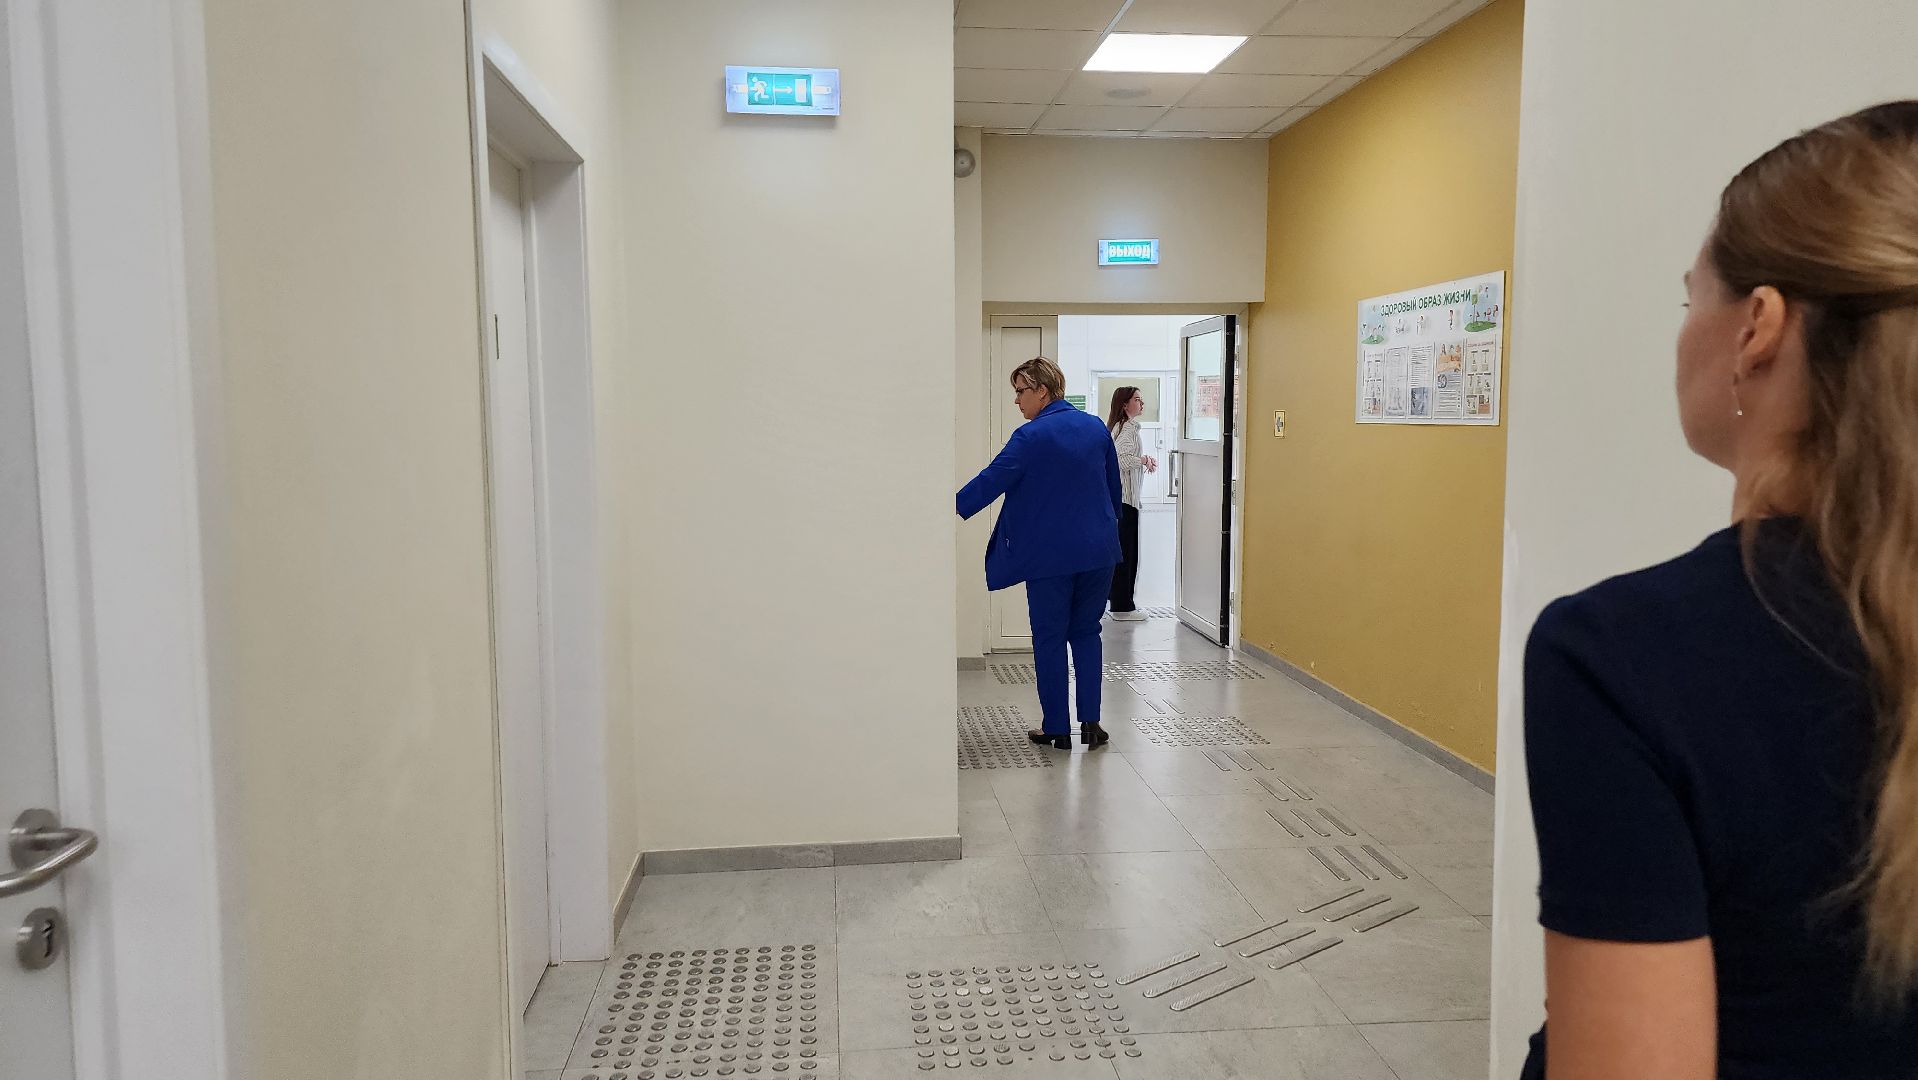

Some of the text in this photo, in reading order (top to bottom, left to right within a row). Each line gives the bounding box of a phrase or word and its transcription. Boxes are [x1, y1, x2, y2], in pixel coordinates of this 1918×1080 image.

[1109, 244, 1150, 259] ВЫХОД
[1380, 289, 1472, 317] ЗДОРОВЫЙ ОБРАЗ ЖИЗНИ
